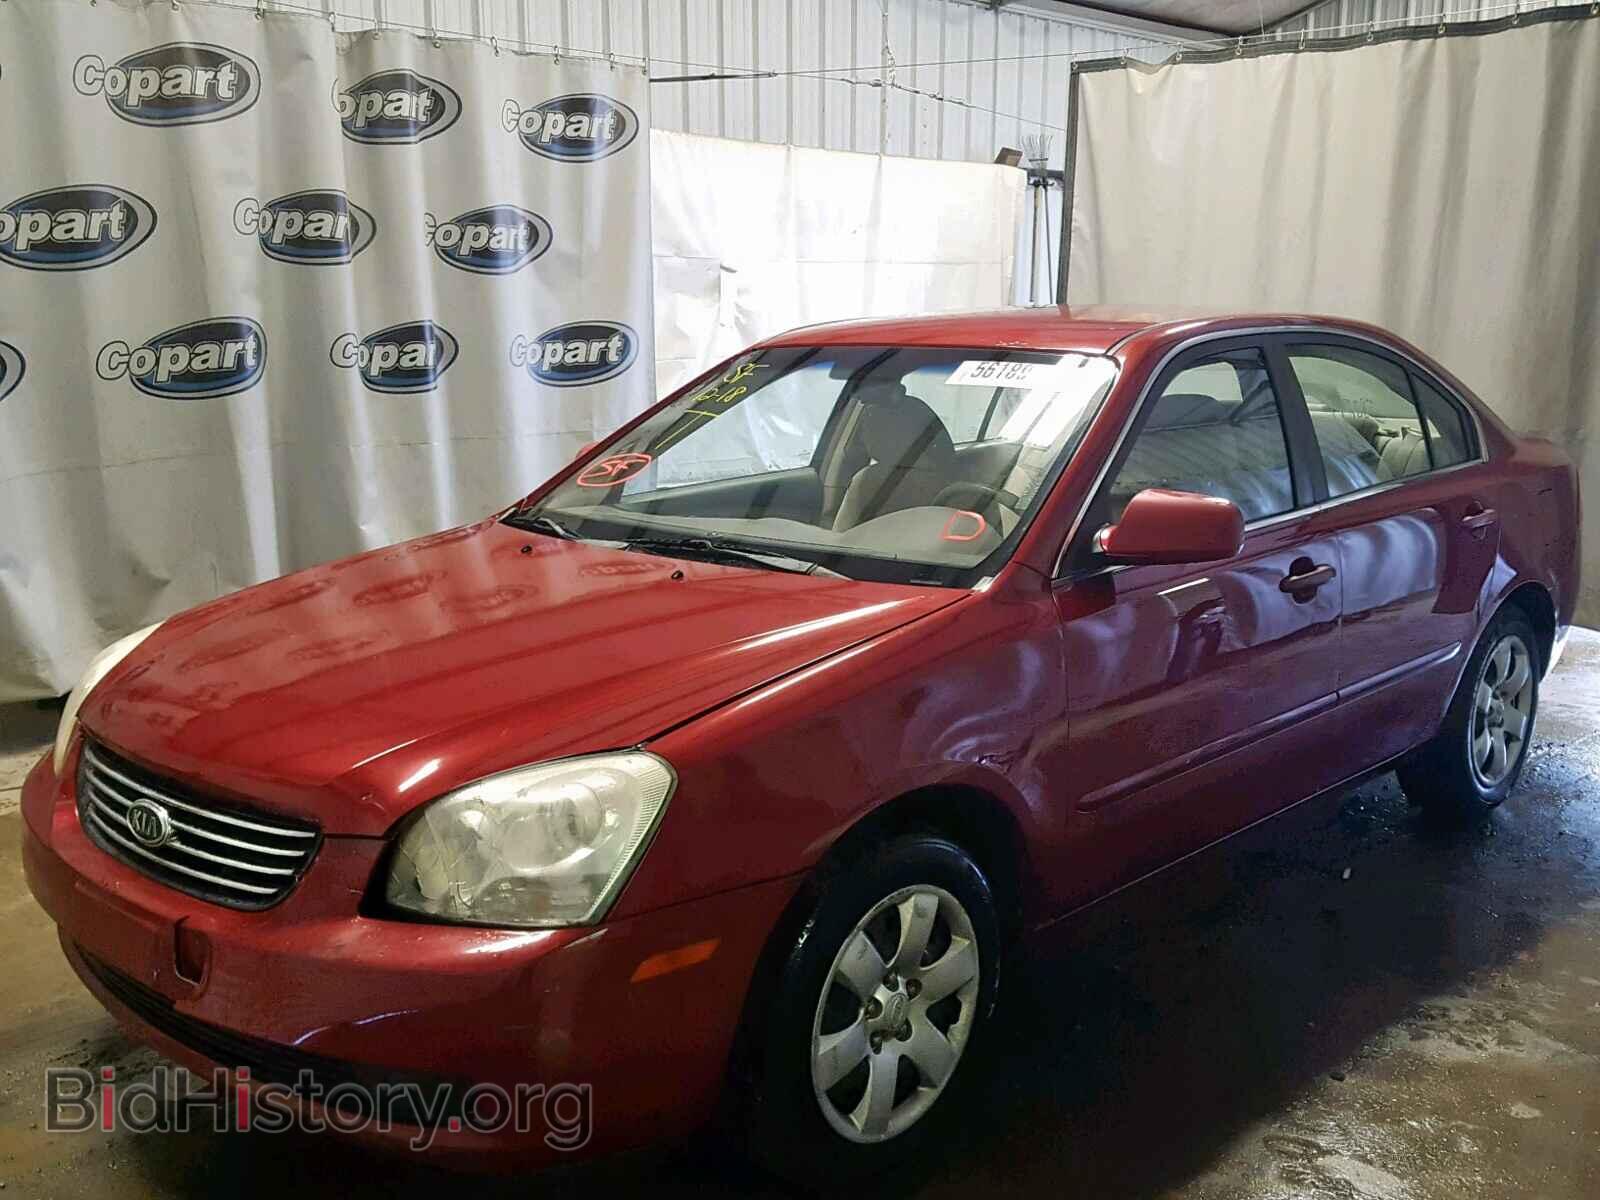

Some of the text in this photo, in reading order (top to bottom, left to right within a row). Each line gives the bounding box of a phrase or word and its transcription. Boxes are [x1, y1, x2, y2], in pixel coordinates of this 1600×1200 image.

[73, 54, 237, 107] Copart
[502, 98, 616, 144] Copart
[0, 199, 126, 253] opart
[96, 331, 258, 384] Copart
[510, 333, 624, 371] Copart
